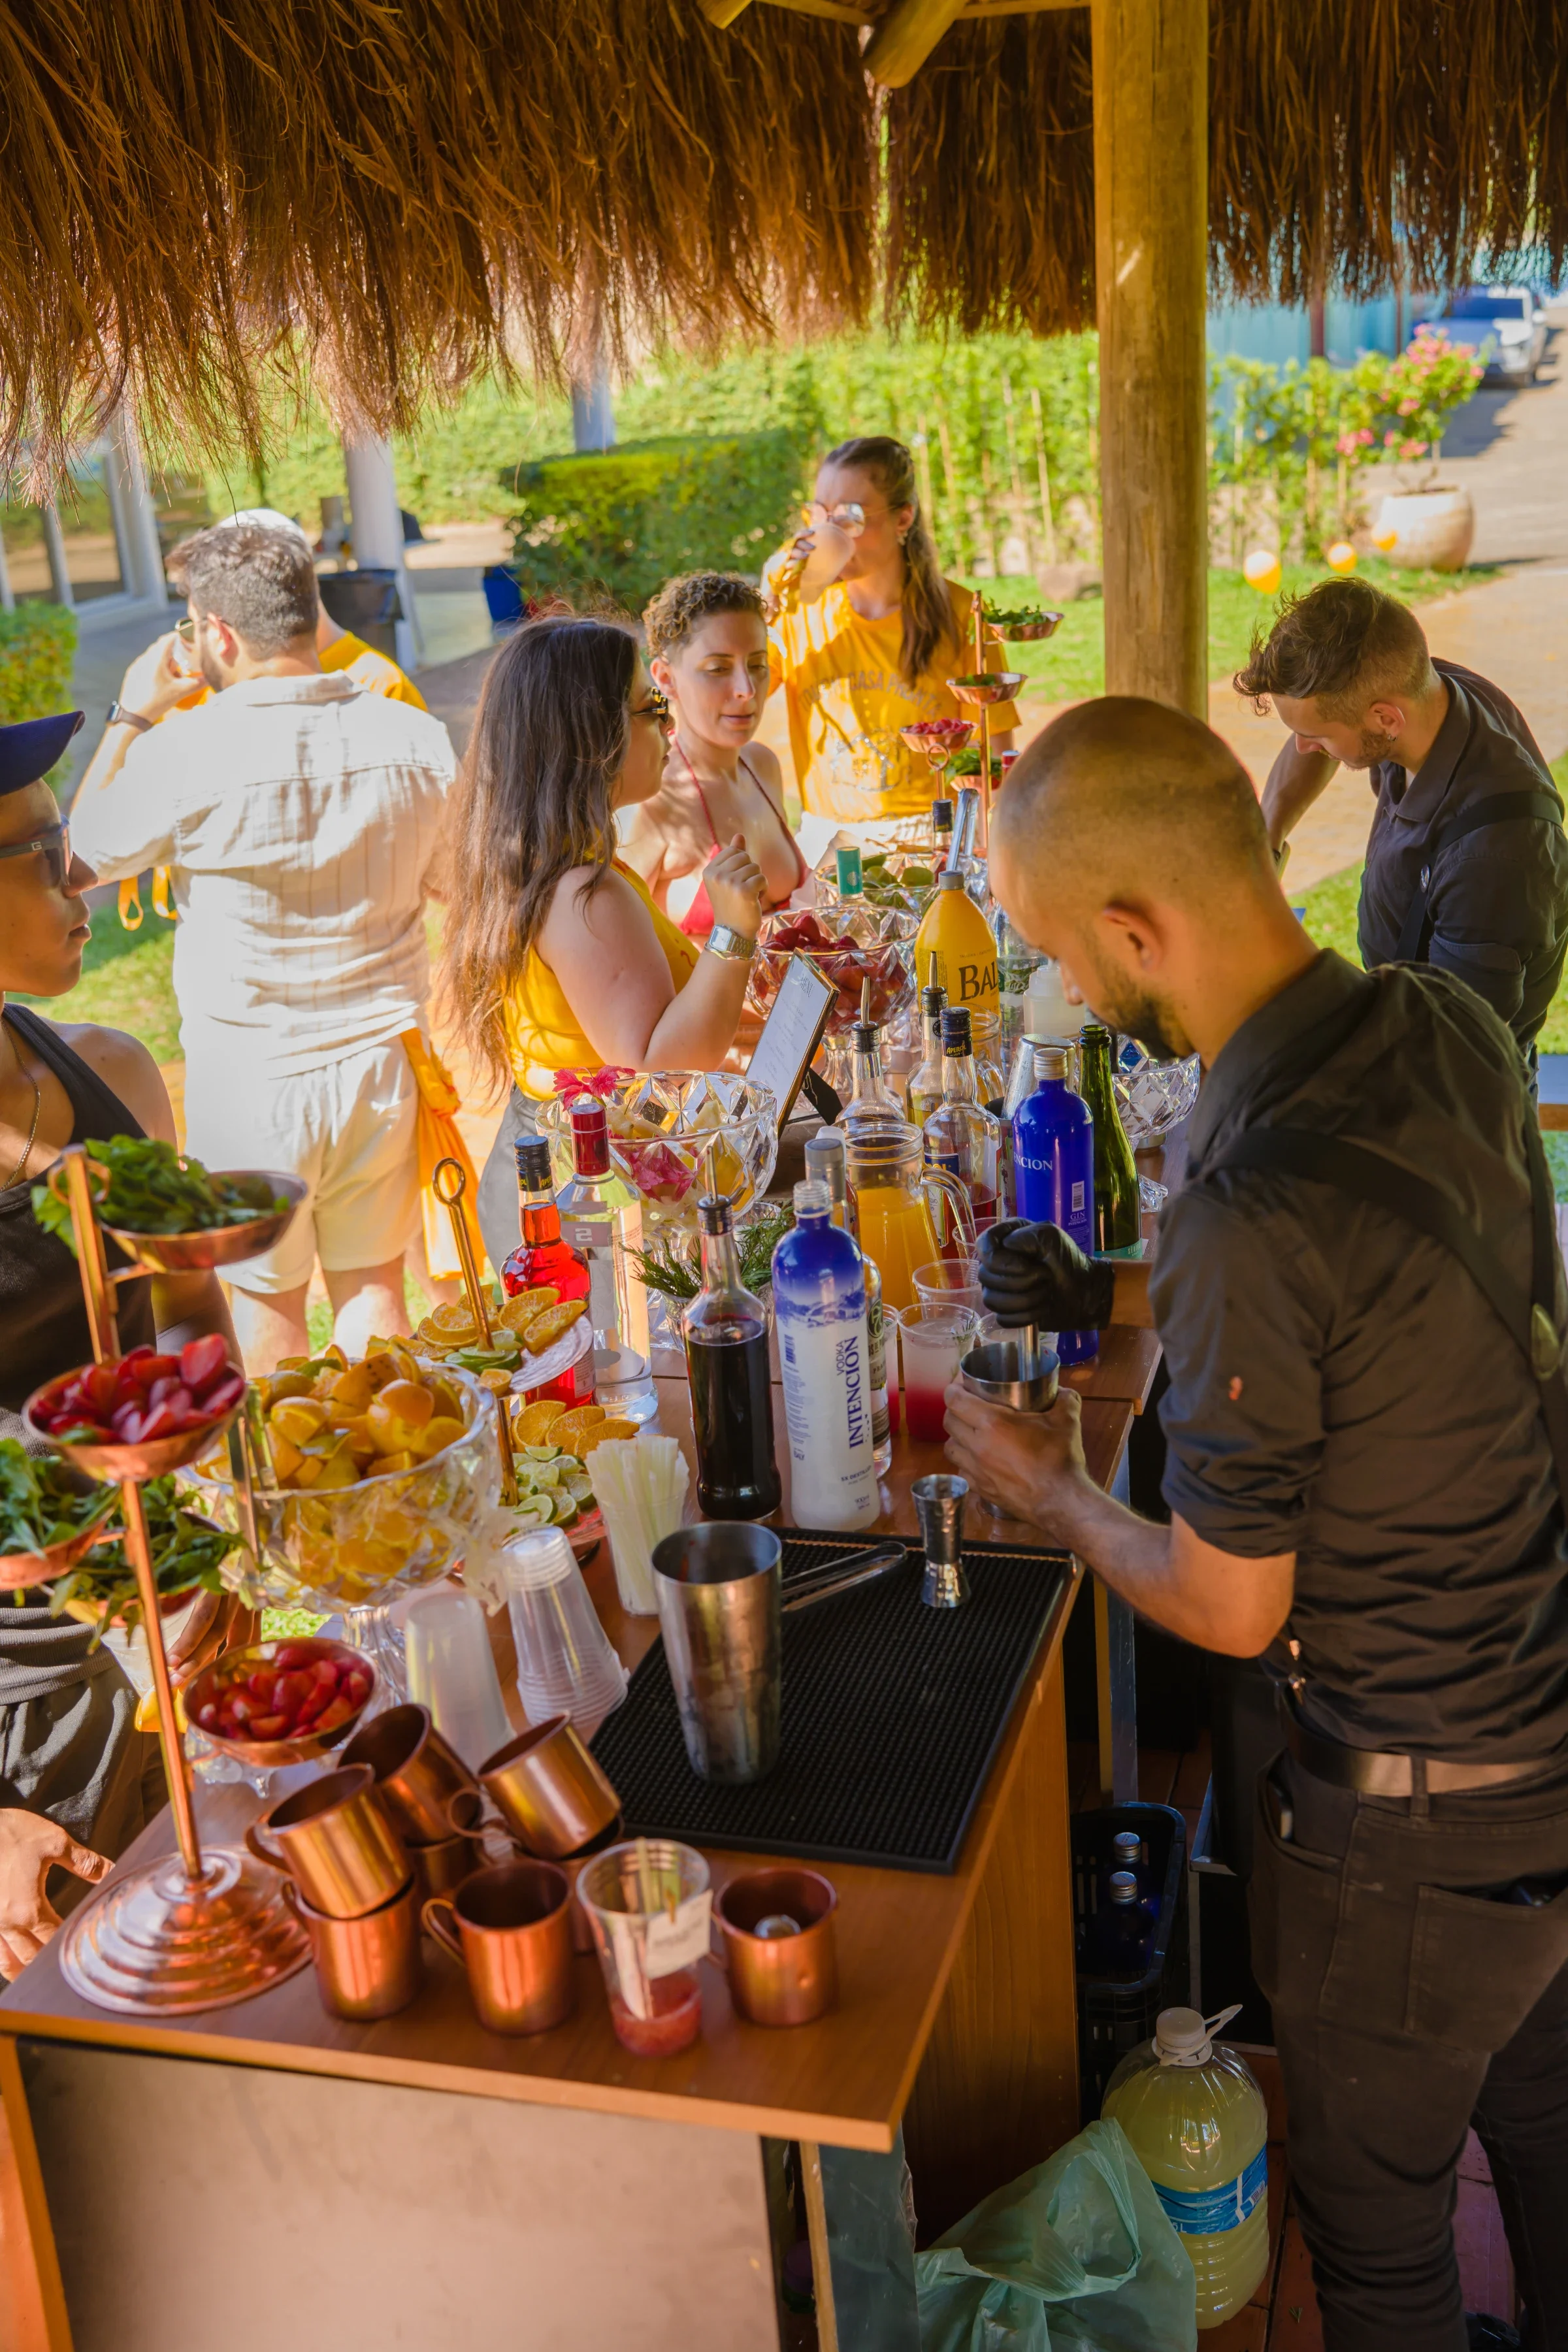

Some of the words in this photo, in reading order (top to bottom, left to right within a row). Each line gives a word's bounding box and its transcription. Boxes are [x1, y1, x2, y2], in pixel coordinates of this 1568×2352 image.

[848, 670, 883, 691] CASA
[798, 974, 815, 998] MENU
[947, 1041, 967, 1054] APEROL
[1070, 1211, 1085, 1220] GIN
[836, 1341, 845, 1376] VODKA
[844, 1335, 864, 1450] INTENCION
